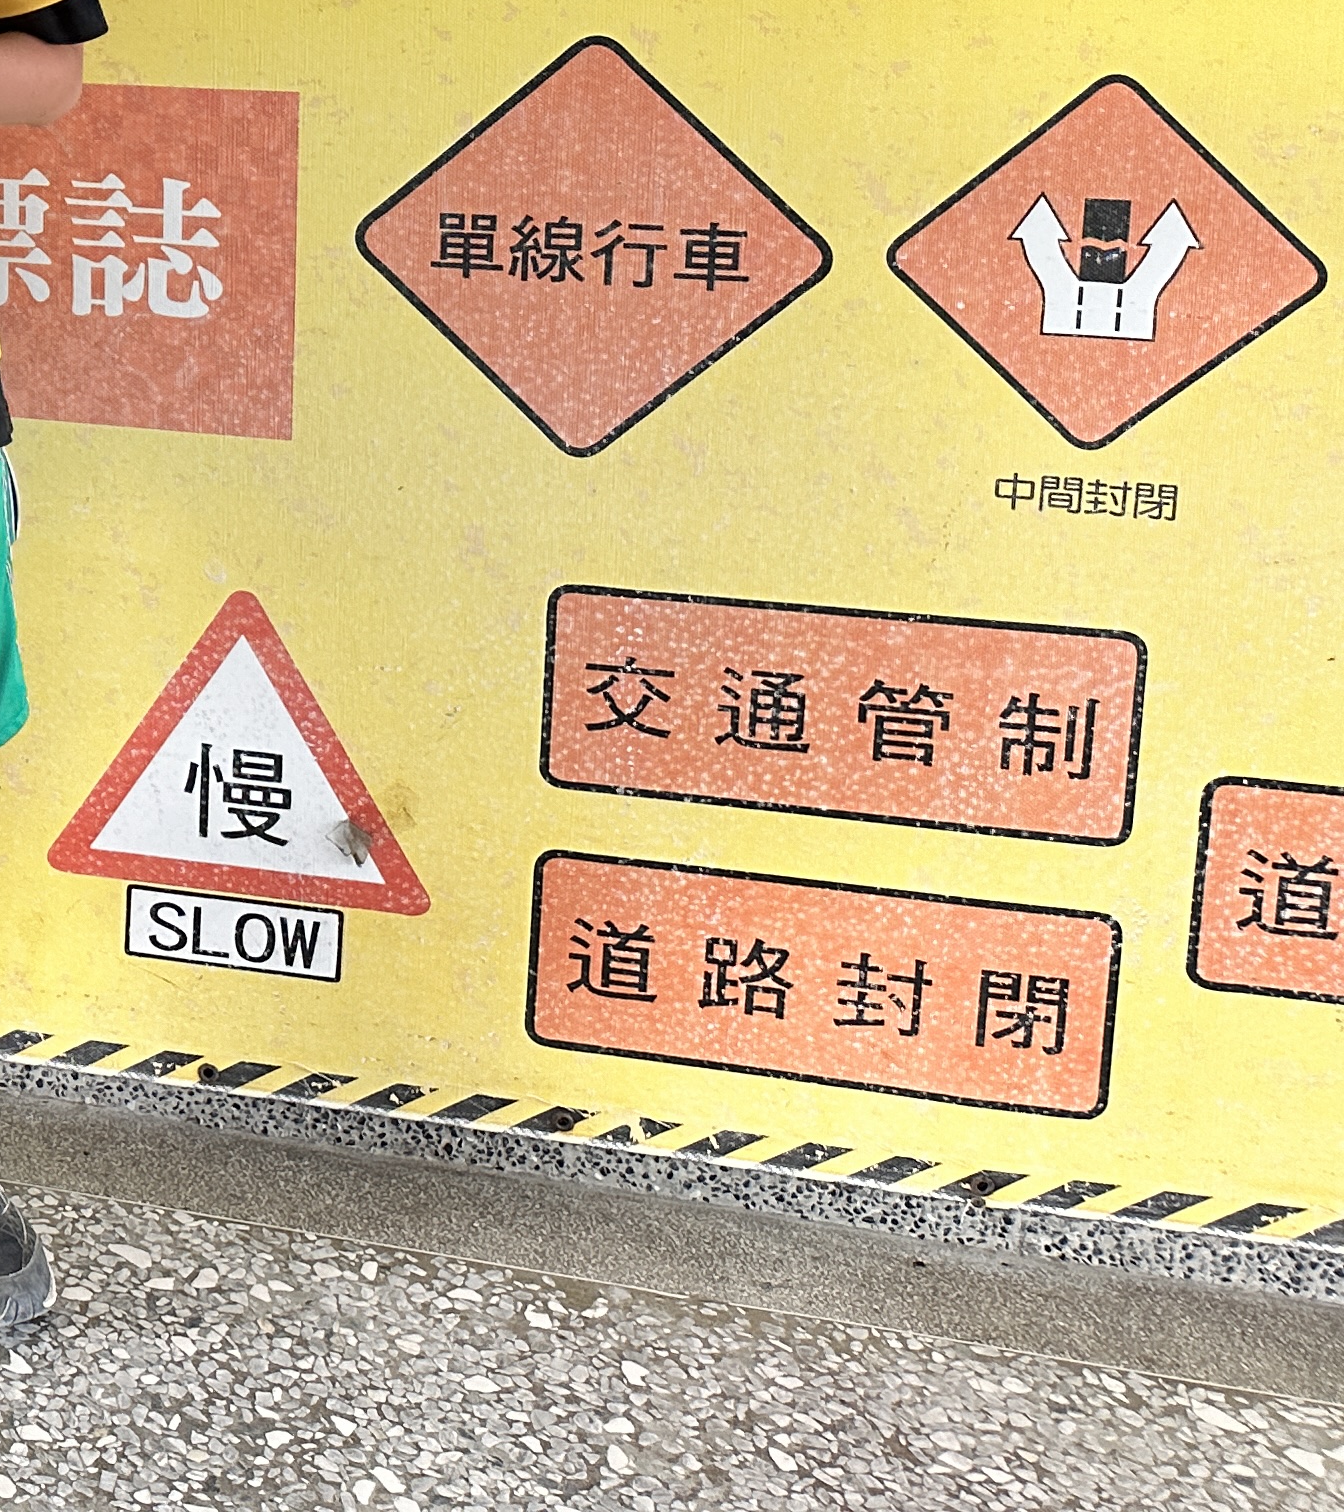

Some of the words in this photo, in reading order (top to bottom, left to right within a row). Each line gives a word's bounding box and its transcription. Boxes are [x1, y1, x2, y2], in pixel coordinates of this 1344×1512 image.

[430, 212, 752, 294] 單線行車
[993, 473, 1178, 522] 中間封閉
[583, 656, 1100, 784] 交通管制
[183, 741, 295, 847] 慢
[147, 902, 321, 970] SLOW
[1237, 846, 1344, 942] 道
[566, 916, 1070, 1058] 道路封閉
